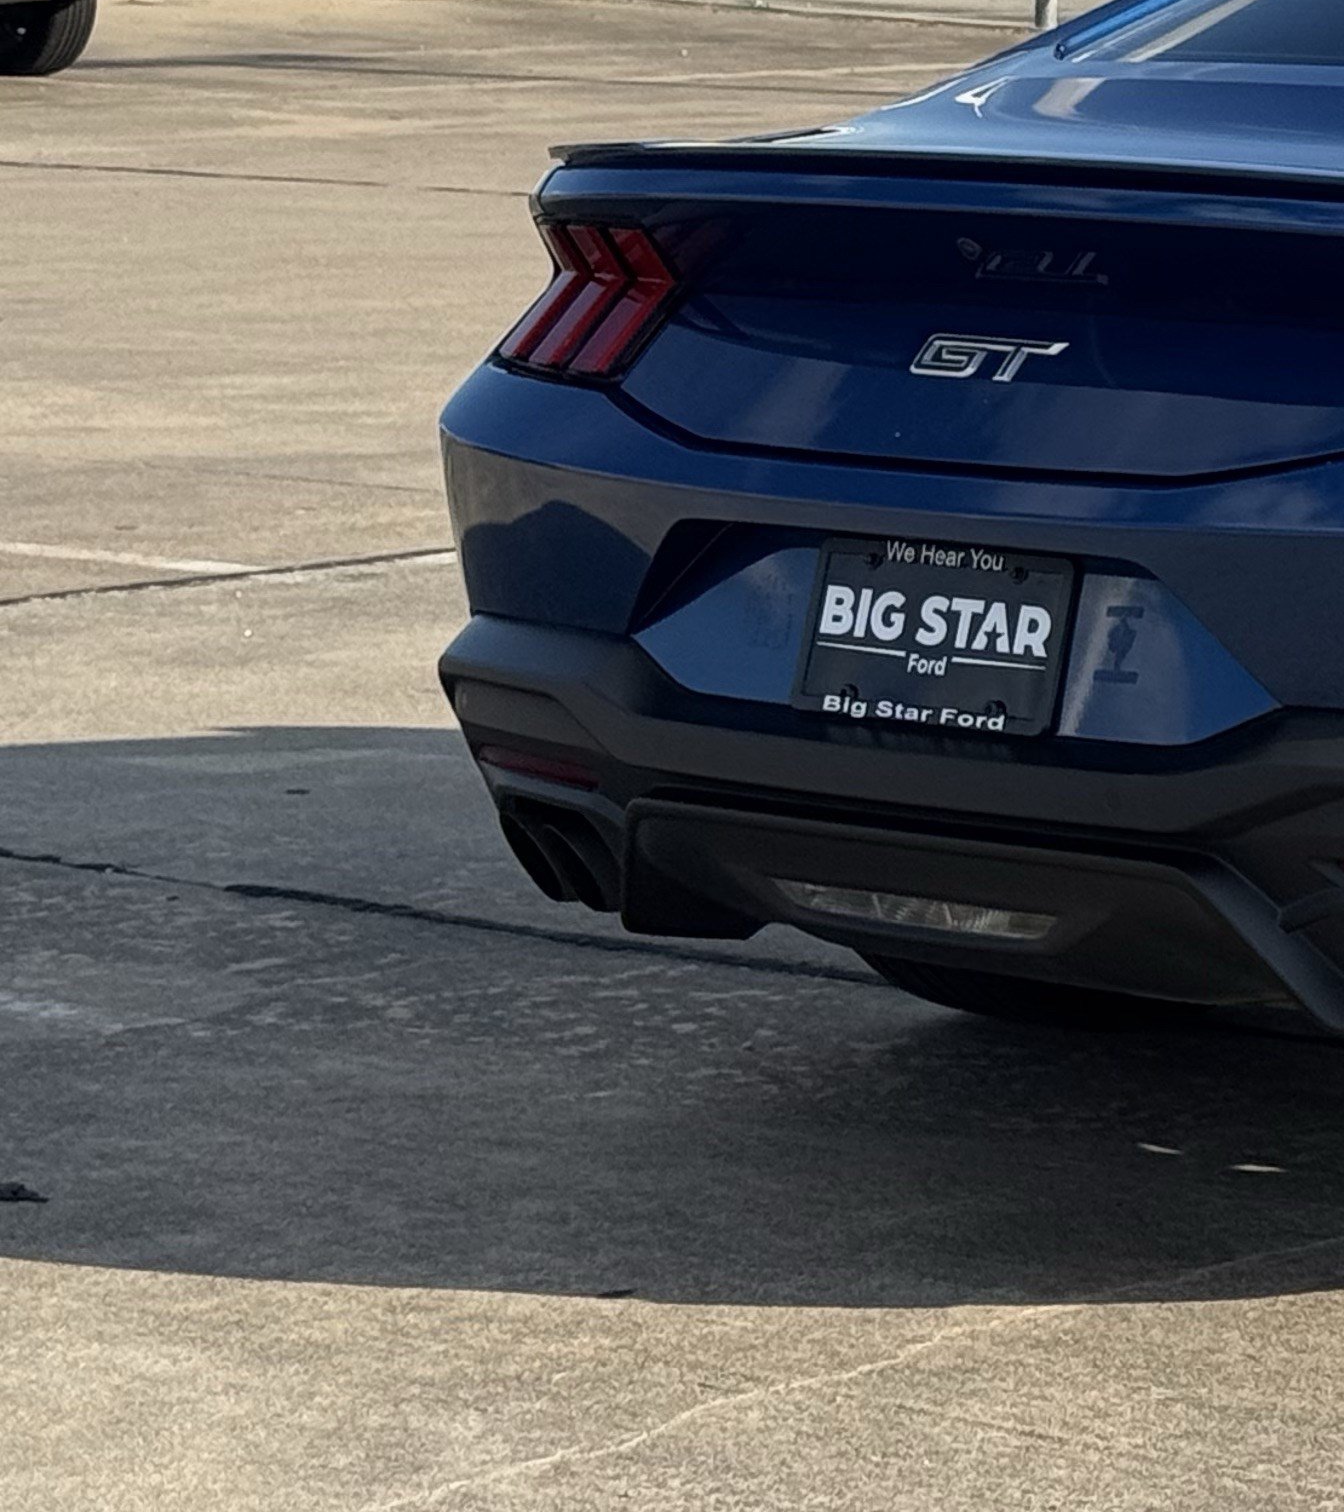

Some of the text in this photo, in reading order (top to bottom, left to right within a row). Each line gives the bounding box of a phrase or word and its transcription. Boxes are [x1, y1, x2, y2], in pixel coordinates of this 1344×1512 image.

[910, 333, 1069, 382] GT
[887, 540, 1003, 571] We Hear You
[819, 585, 1051, 658] BIG STAR
[907, 653, 947, 676] Ford
[822, 695, 1005, 731] Big Star Ford
